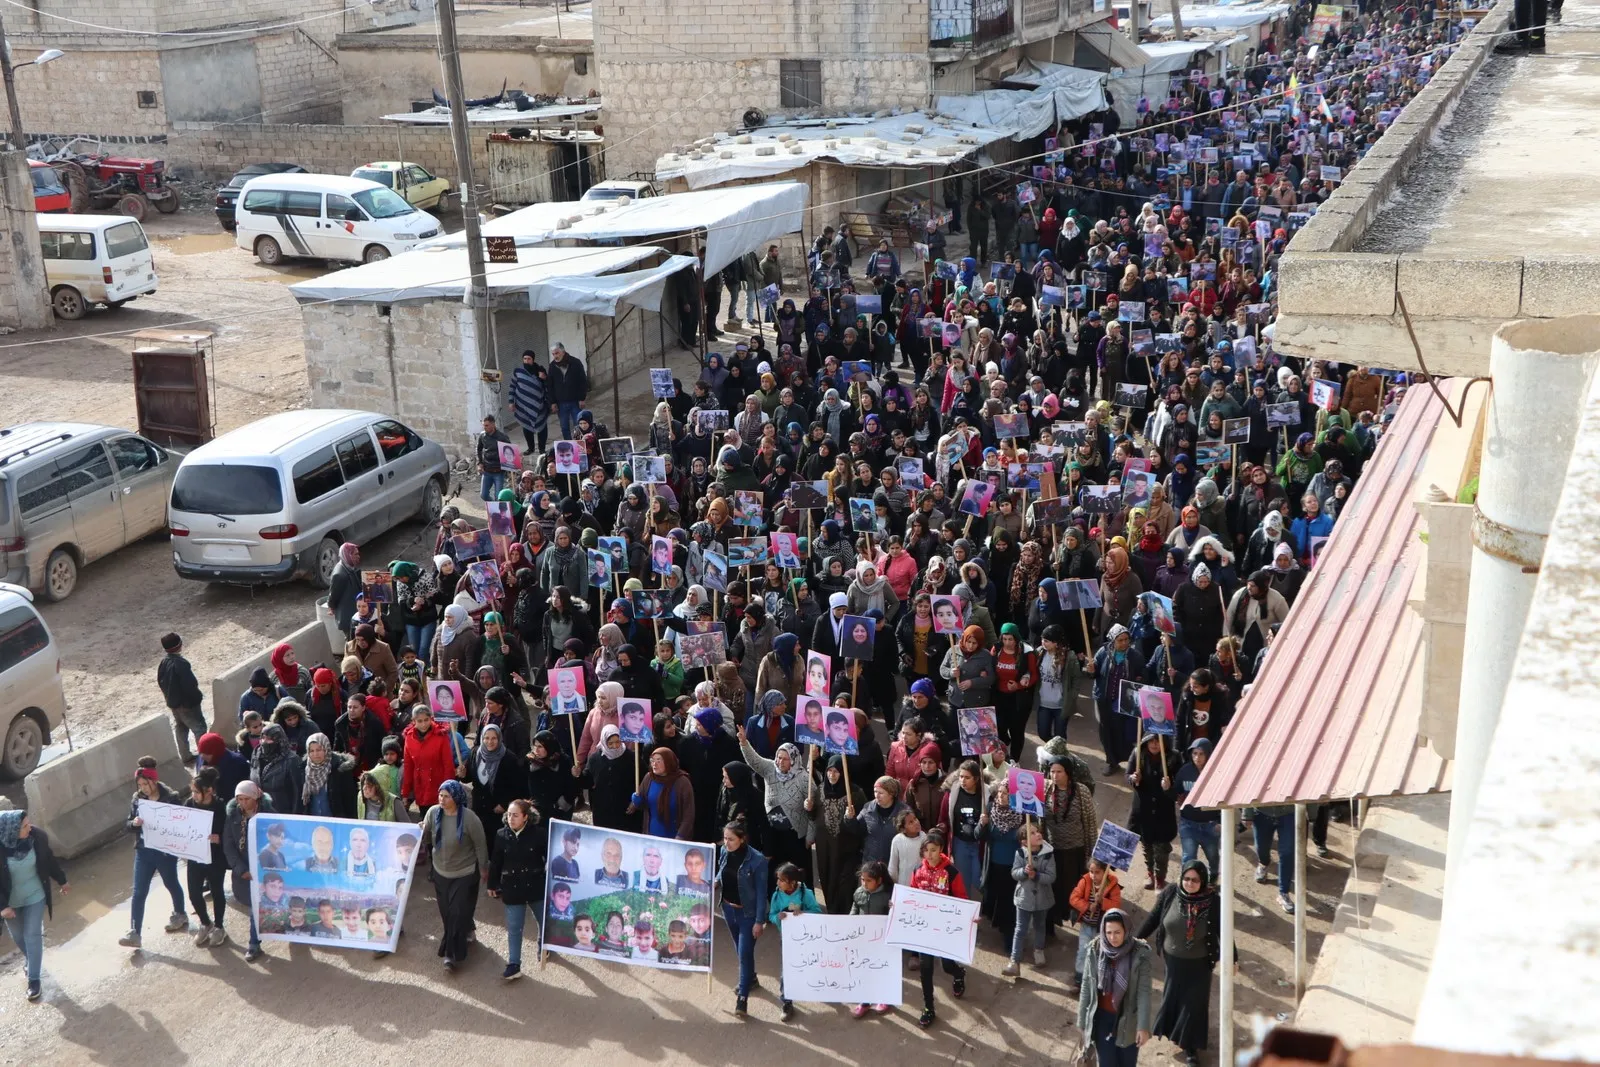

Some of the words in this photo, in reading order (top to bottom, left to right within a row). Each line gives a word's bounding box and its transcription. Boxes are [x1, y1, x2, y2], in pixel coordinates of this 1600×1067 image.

[902, 893, 937, 911] سورية
[939, 903, 962, 915] عاشت
[825, 925, 866, 943] للصمت
[868, 927, 884, 942] لا
[945, 920, 963, 935] حرة
